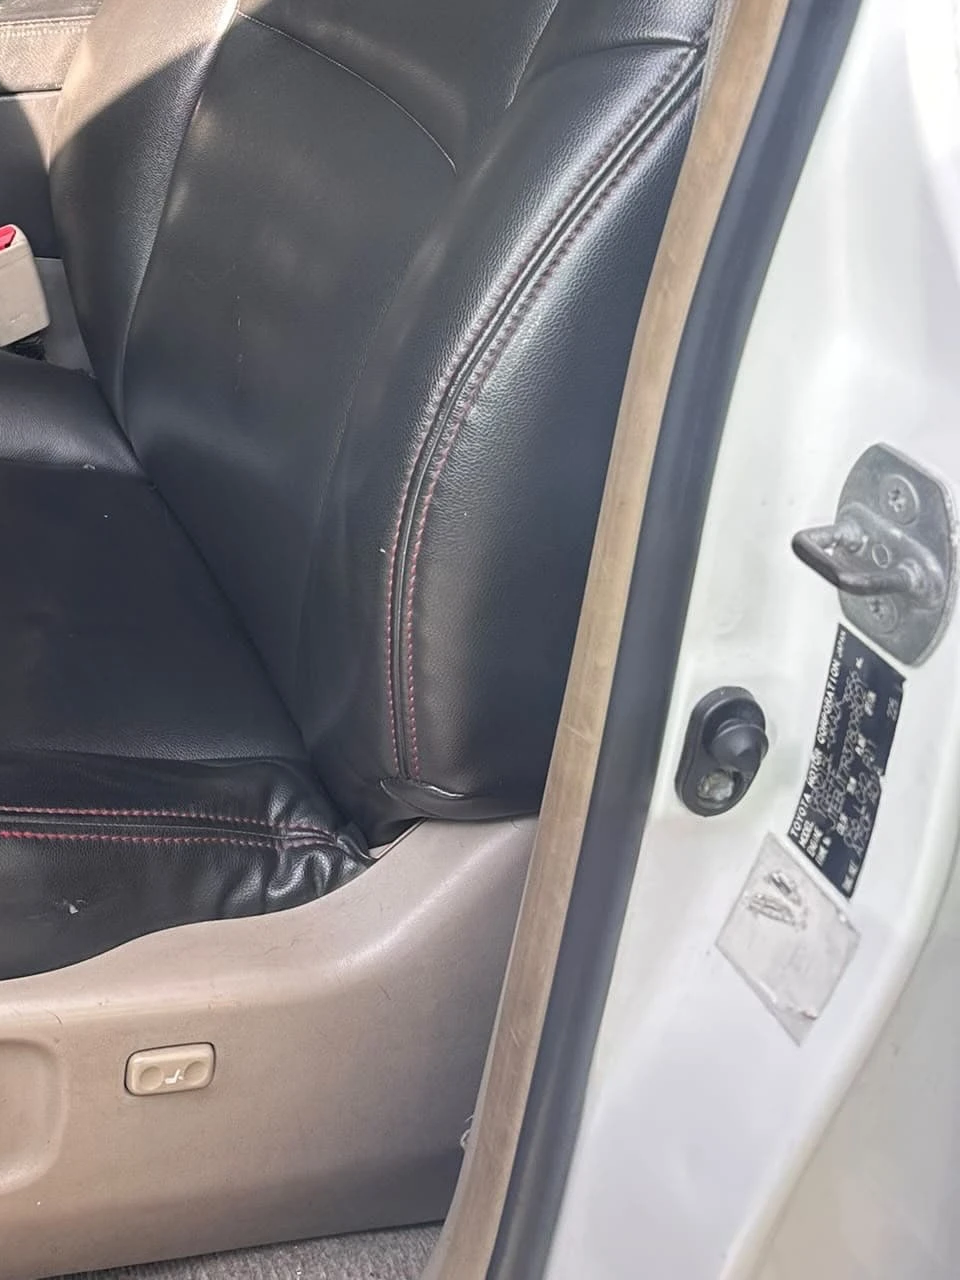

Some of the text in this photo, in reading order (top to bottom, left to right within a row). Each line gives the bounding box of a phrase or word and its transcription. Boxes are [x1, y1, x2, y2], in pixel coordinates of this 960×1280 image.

[792, 793, 811, 837] TOYOTA
[807, 748, 820, 788] MOTOR
[818, 659, 840, 744] CORPORATION
